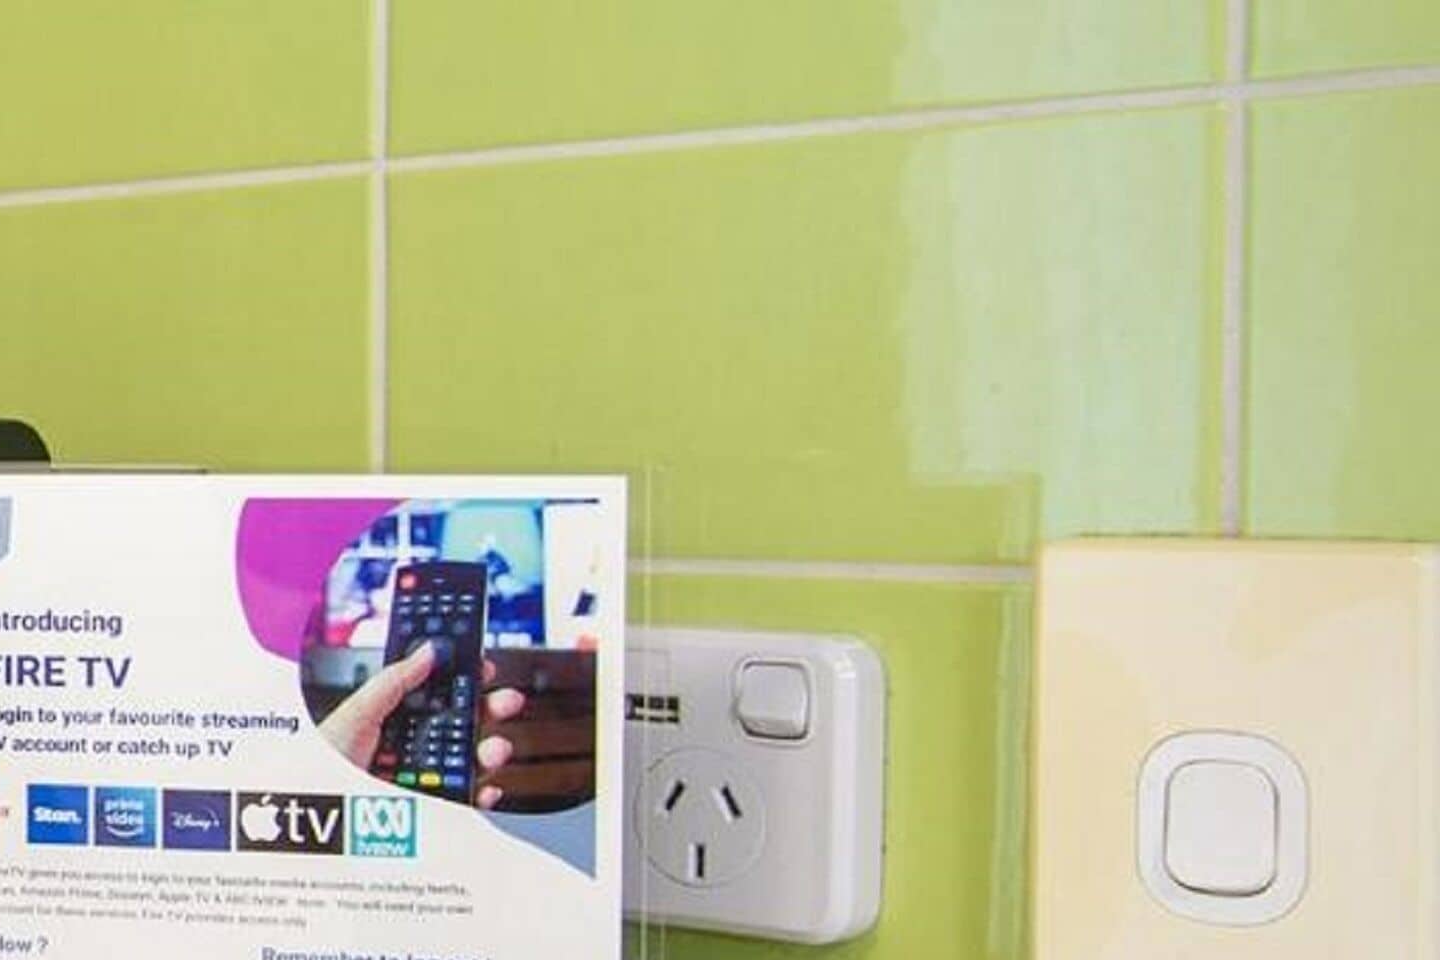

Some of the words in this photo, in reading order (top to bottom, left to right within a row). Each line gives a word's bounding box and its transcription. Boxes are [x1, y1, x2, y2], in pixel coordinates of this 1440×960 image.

[77, 657, 132, 688] TV
[38, 708, 57, 723] to
[61, 711, 102, 728] your
[109, 707, 196, 726] favourite
[202, 712, 300, 734] streaming
[13, 738, 87, 753] account
[92, 741, 111, 754] or
[117, 738, 169, 755] catch
[176, 743, 201, 759] up
[207, 740, 233, 756] TV
[105, 812, 144, 826] video
[283, 799, 340, 844] tv
[38, 936, 49, 952] ?
